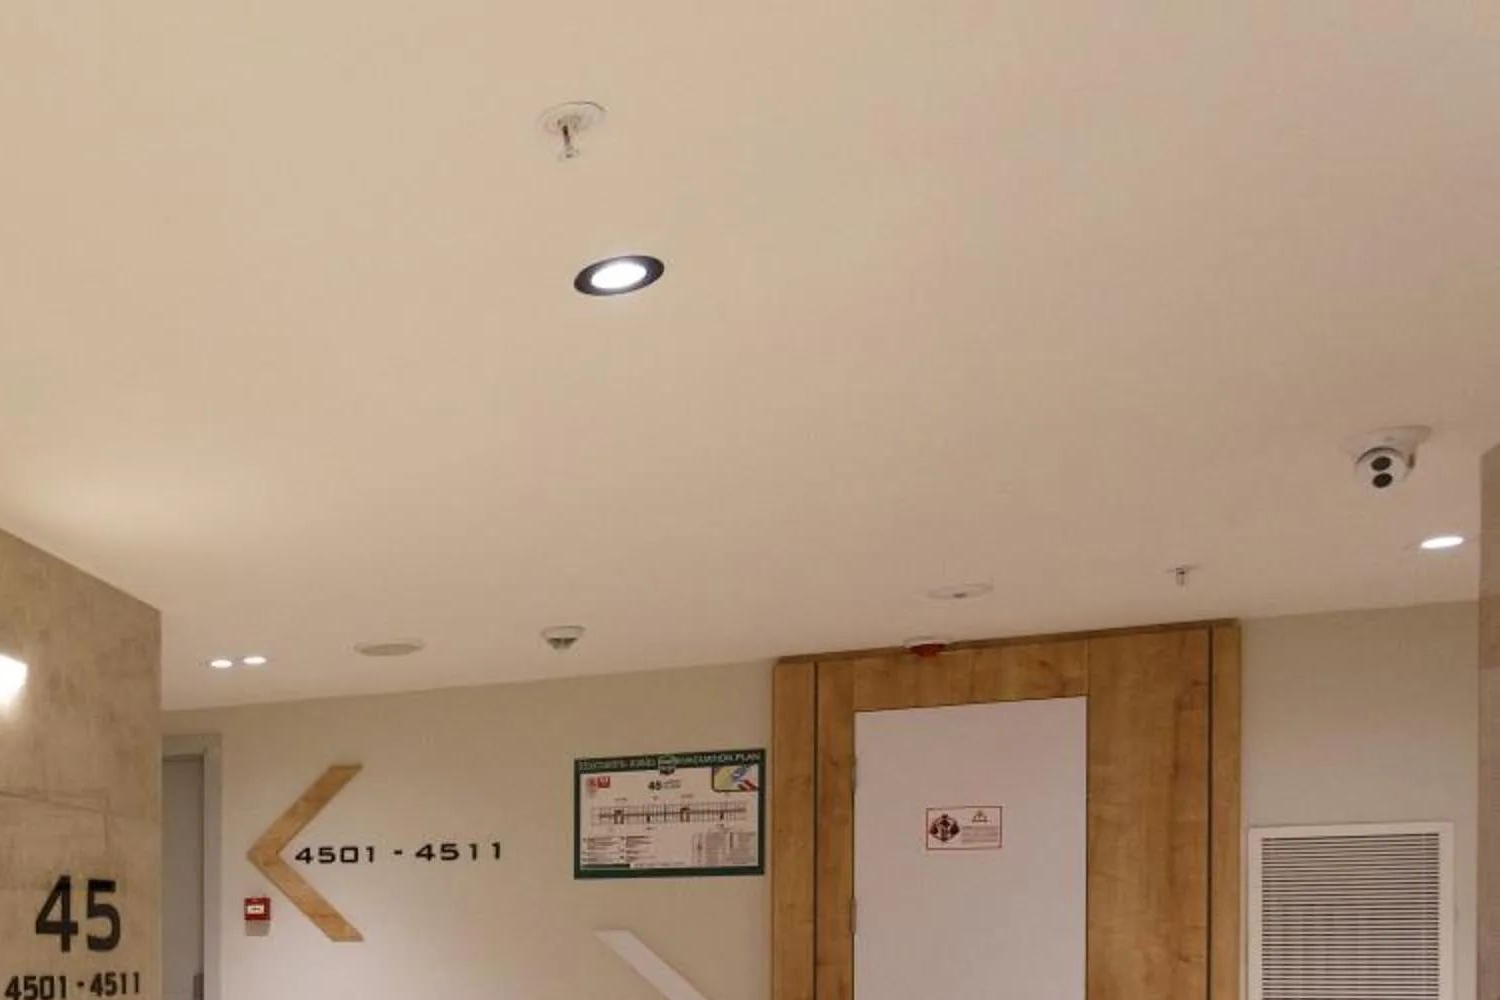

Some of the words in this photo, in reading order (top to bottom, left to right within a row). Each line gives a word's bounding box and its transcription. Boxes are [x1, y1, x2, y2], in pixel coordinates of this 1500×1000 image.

[294, 846, 375, 864] 4501
[415, 842, 501, 861] 4511
[35, 875, 121, 952] 45
[90, 972, 140, 997] 4511
